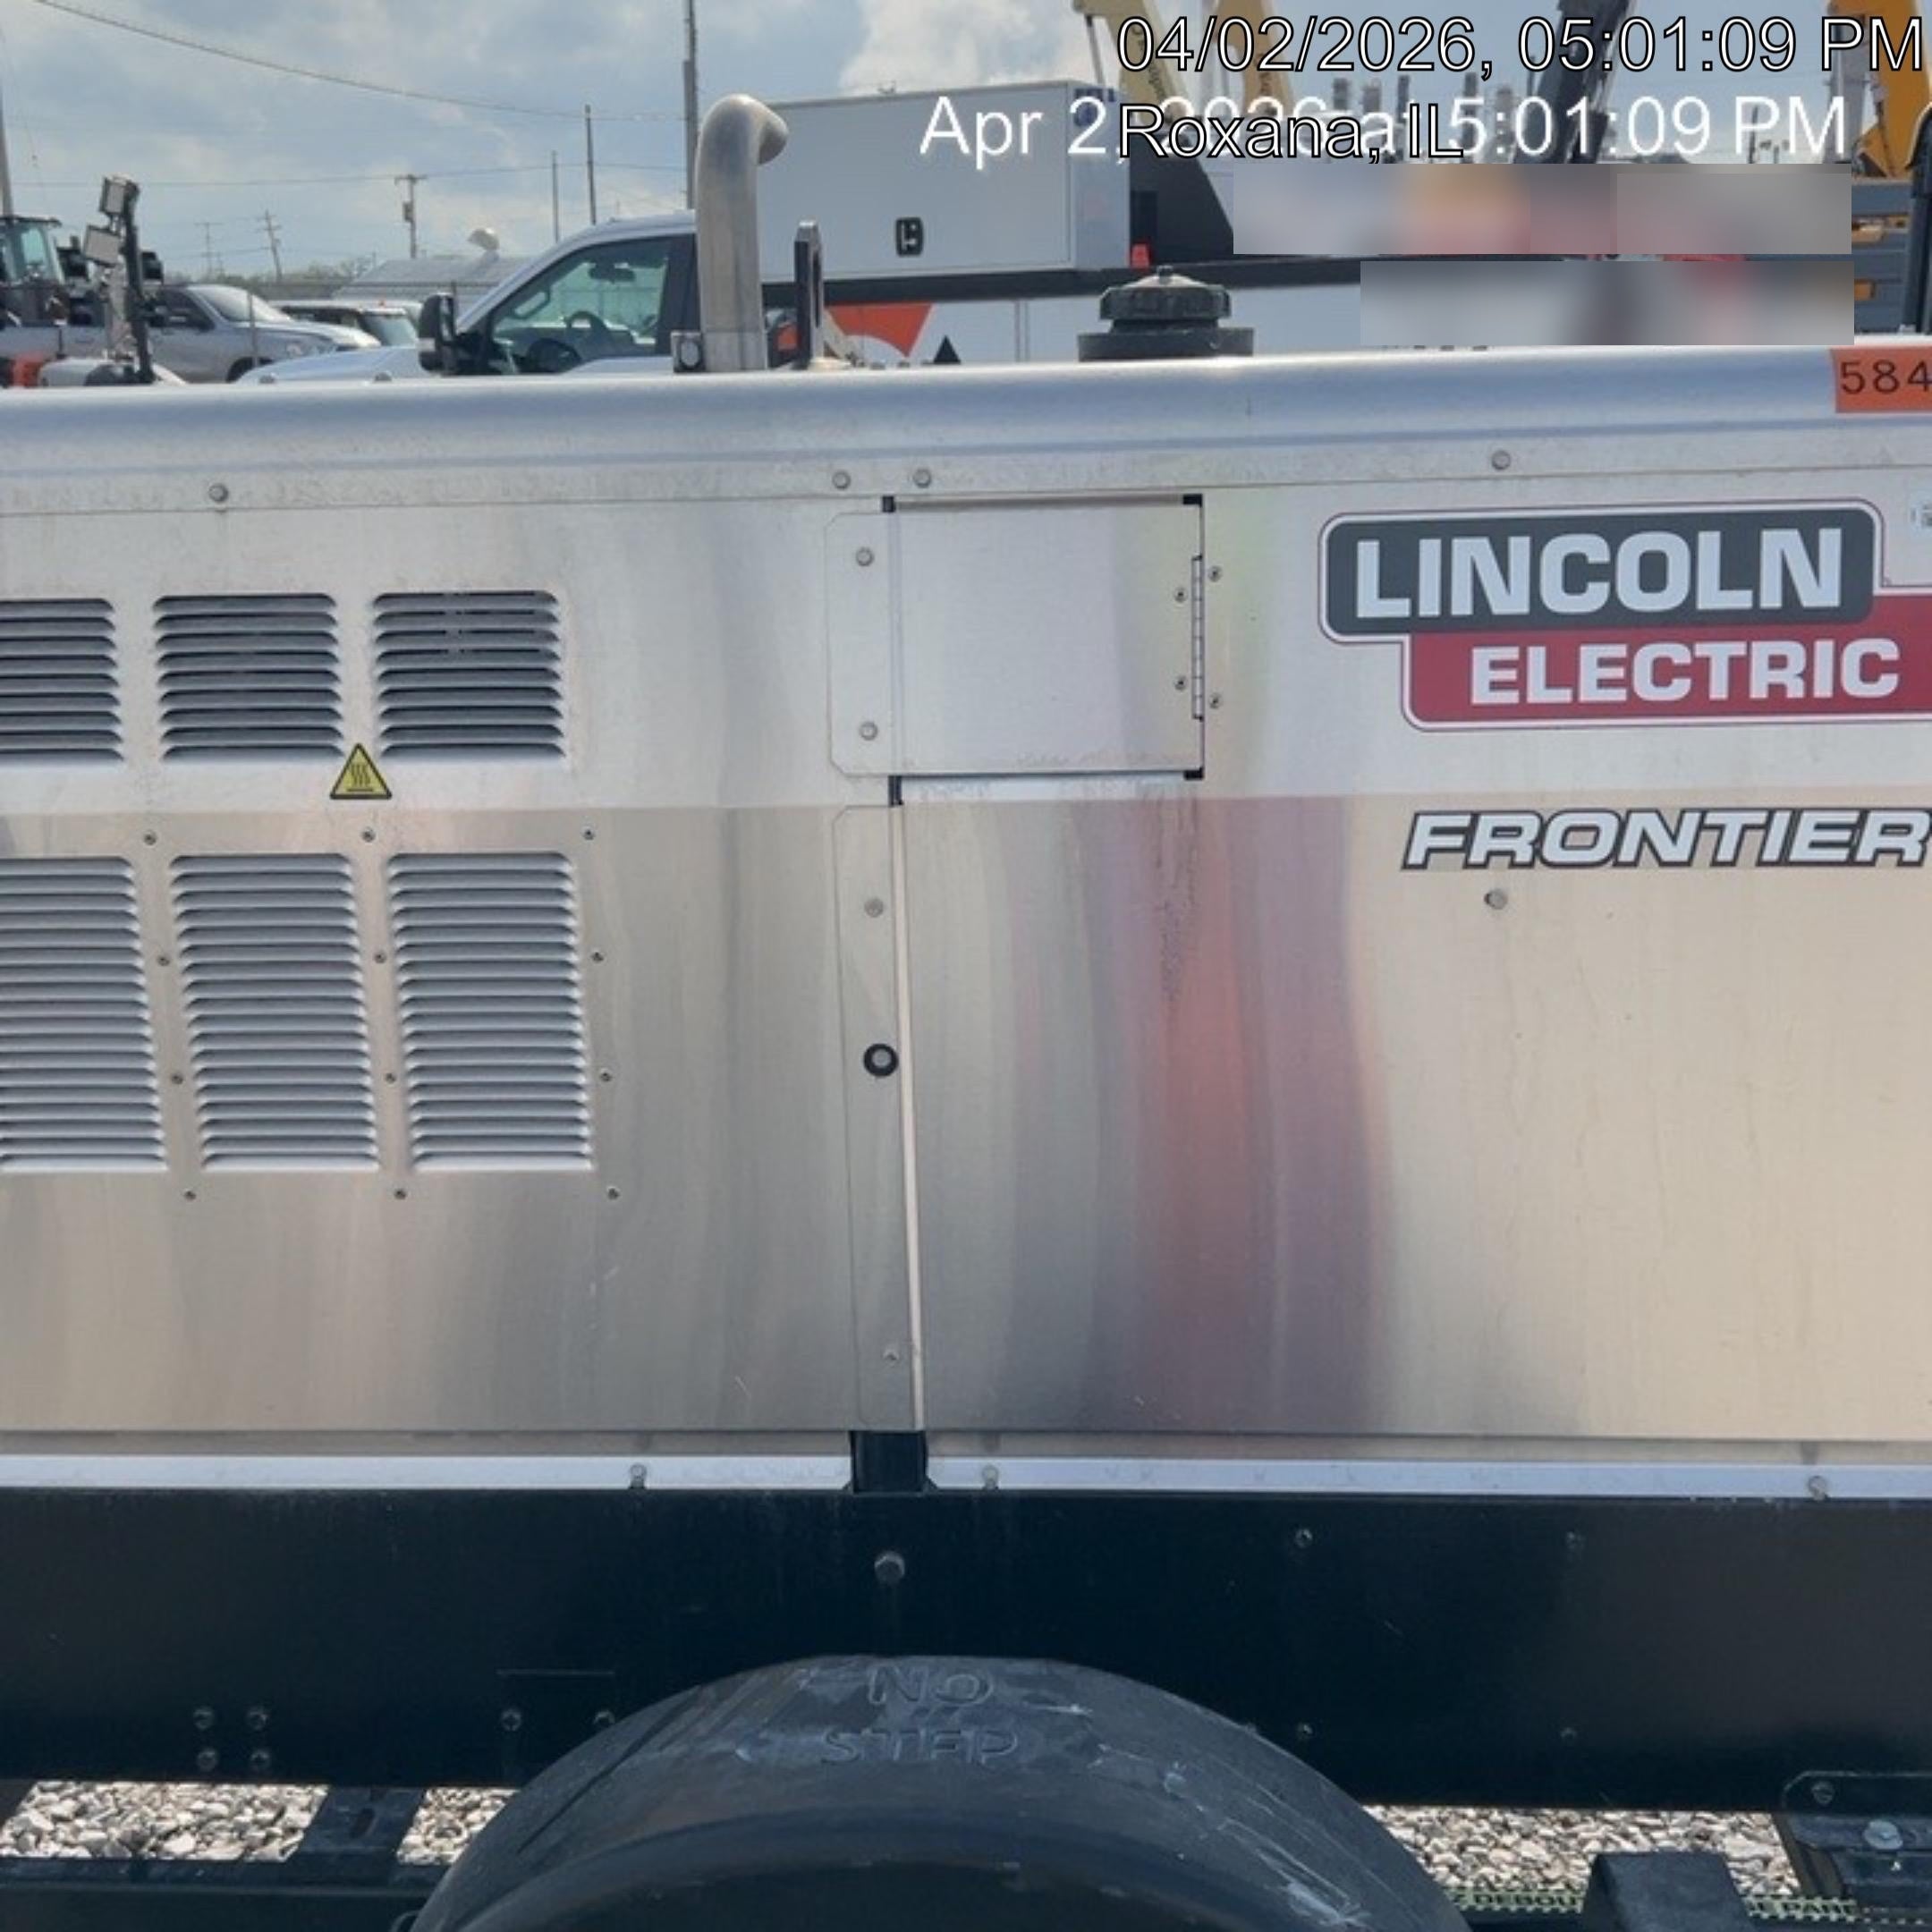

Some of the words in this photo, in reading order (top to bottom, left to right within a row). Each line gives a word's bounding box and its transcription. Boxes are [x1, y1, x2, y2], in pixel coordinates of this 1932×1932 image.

[1356, 528, 1842, 617] LINCOLN
[1471, 638, 1900, 705] ELECTRIC
[1401, 809, 1932, 869] FRONTIER
[868, 1665, 995, 1705] NO
[820, 1727, 1018, 1765] STEP
